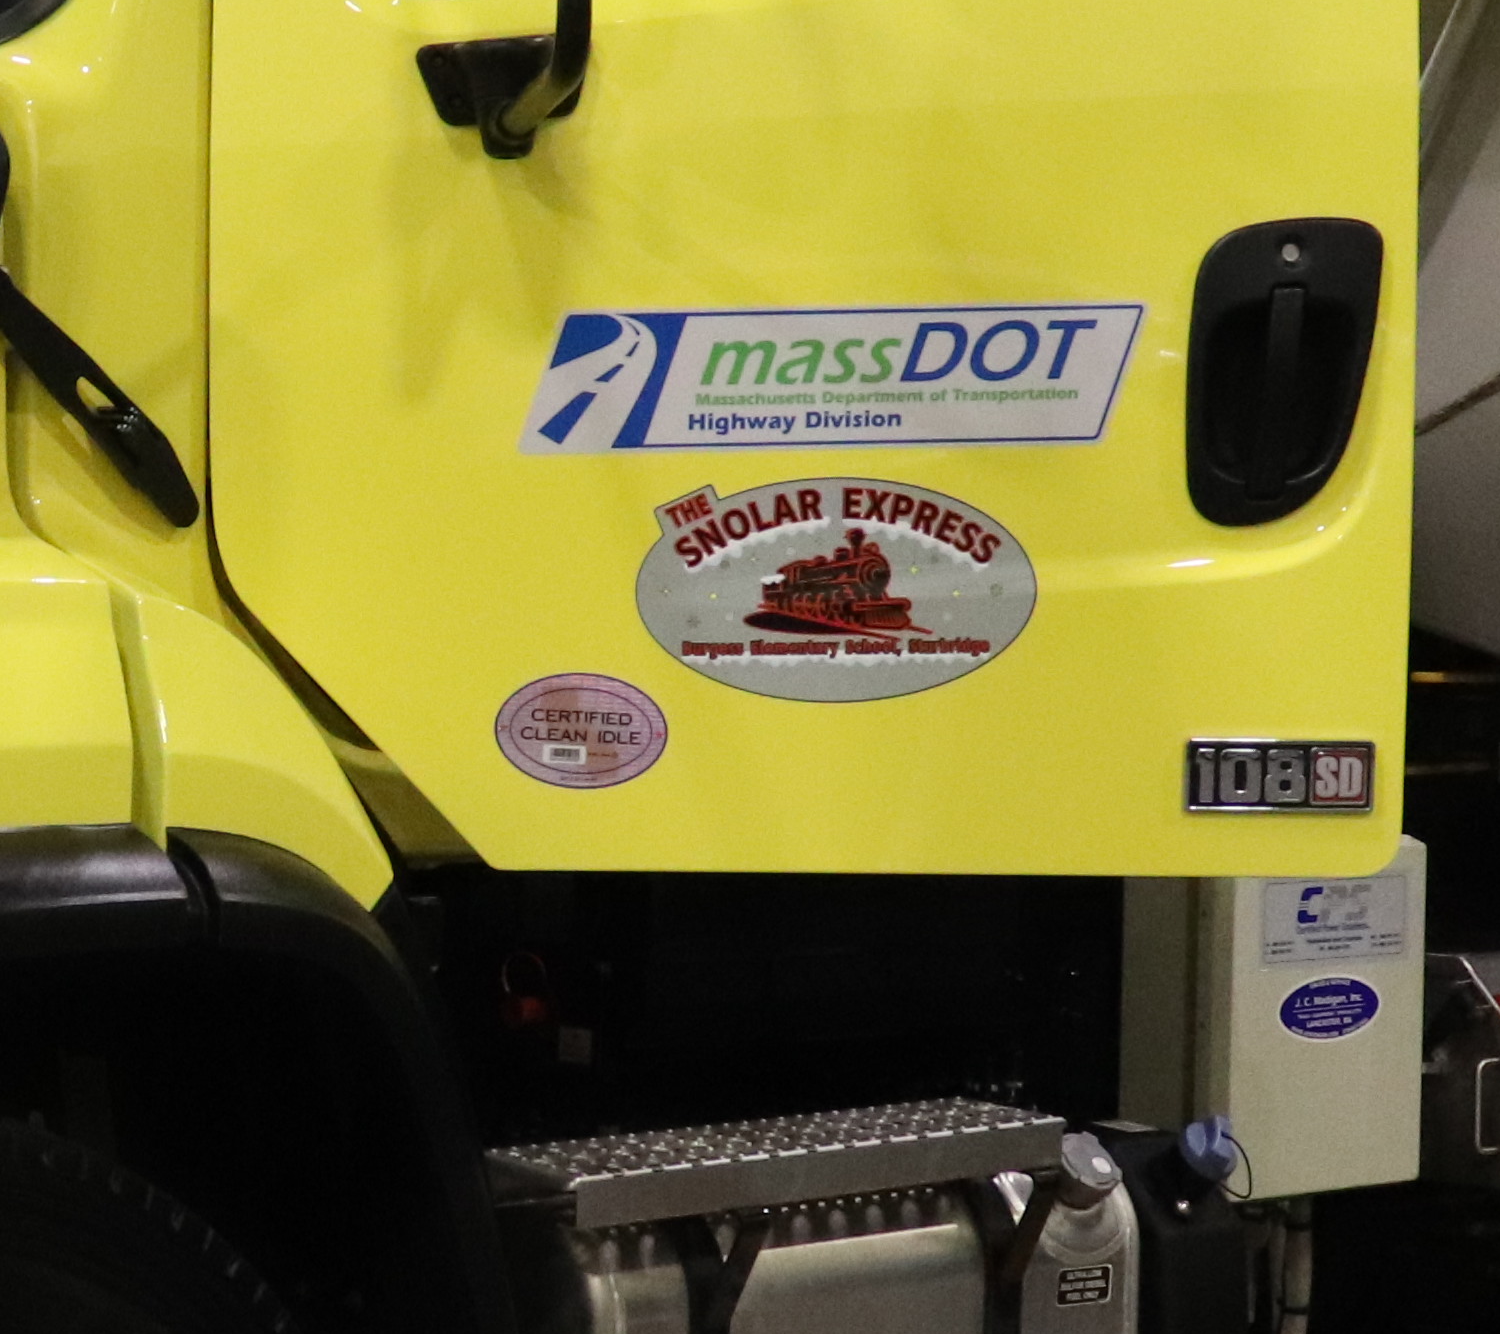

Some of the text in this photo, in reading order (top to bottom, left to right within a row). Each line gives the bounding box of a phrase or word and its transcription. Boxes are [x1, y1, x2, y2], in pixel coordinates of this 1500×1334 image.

[700, 318, 1098, 386] massDOT
[694, 386, 1080, 407] Massachusetts Department of Transportation
[687, 410, 902, 435] Highway Division
[664, 493, 715, 528] THE
[674, 487, 1003, 569] SNOLAR EXPRESS
[681, 637, 991, 661] Burgess Elementary School, Sturbridge
[531, 708, 633, 726] CERTIFIED
[520, 726, 642, 745] CLEAN IDLE
[1195, 747, 1364, 804] 108 SD
